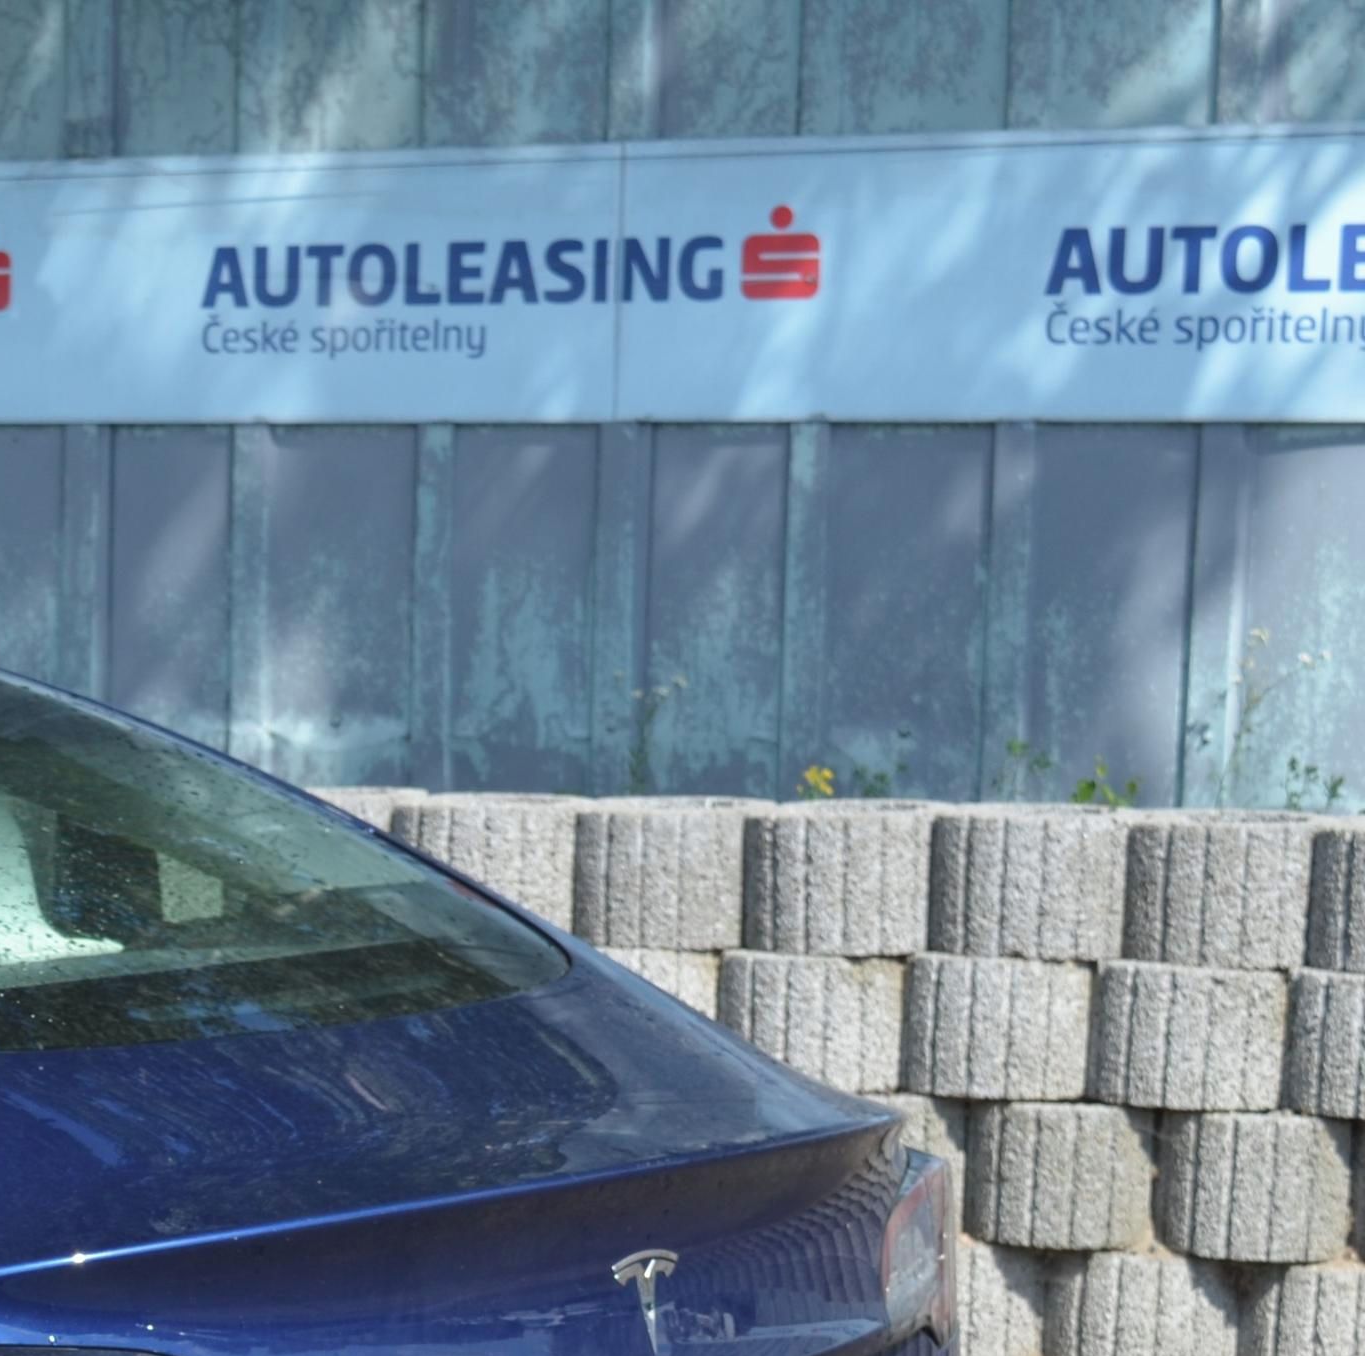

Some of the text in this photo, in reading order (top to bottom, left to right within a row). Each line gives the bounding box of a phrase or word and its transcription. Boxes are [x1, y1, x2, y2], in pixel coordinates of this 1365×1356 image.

[200, 235, 724, 308] AUTOLEASING
[202, 314, 486, 358] České spořitelny
[1045, 301, 1365, 352] České spořiteln
